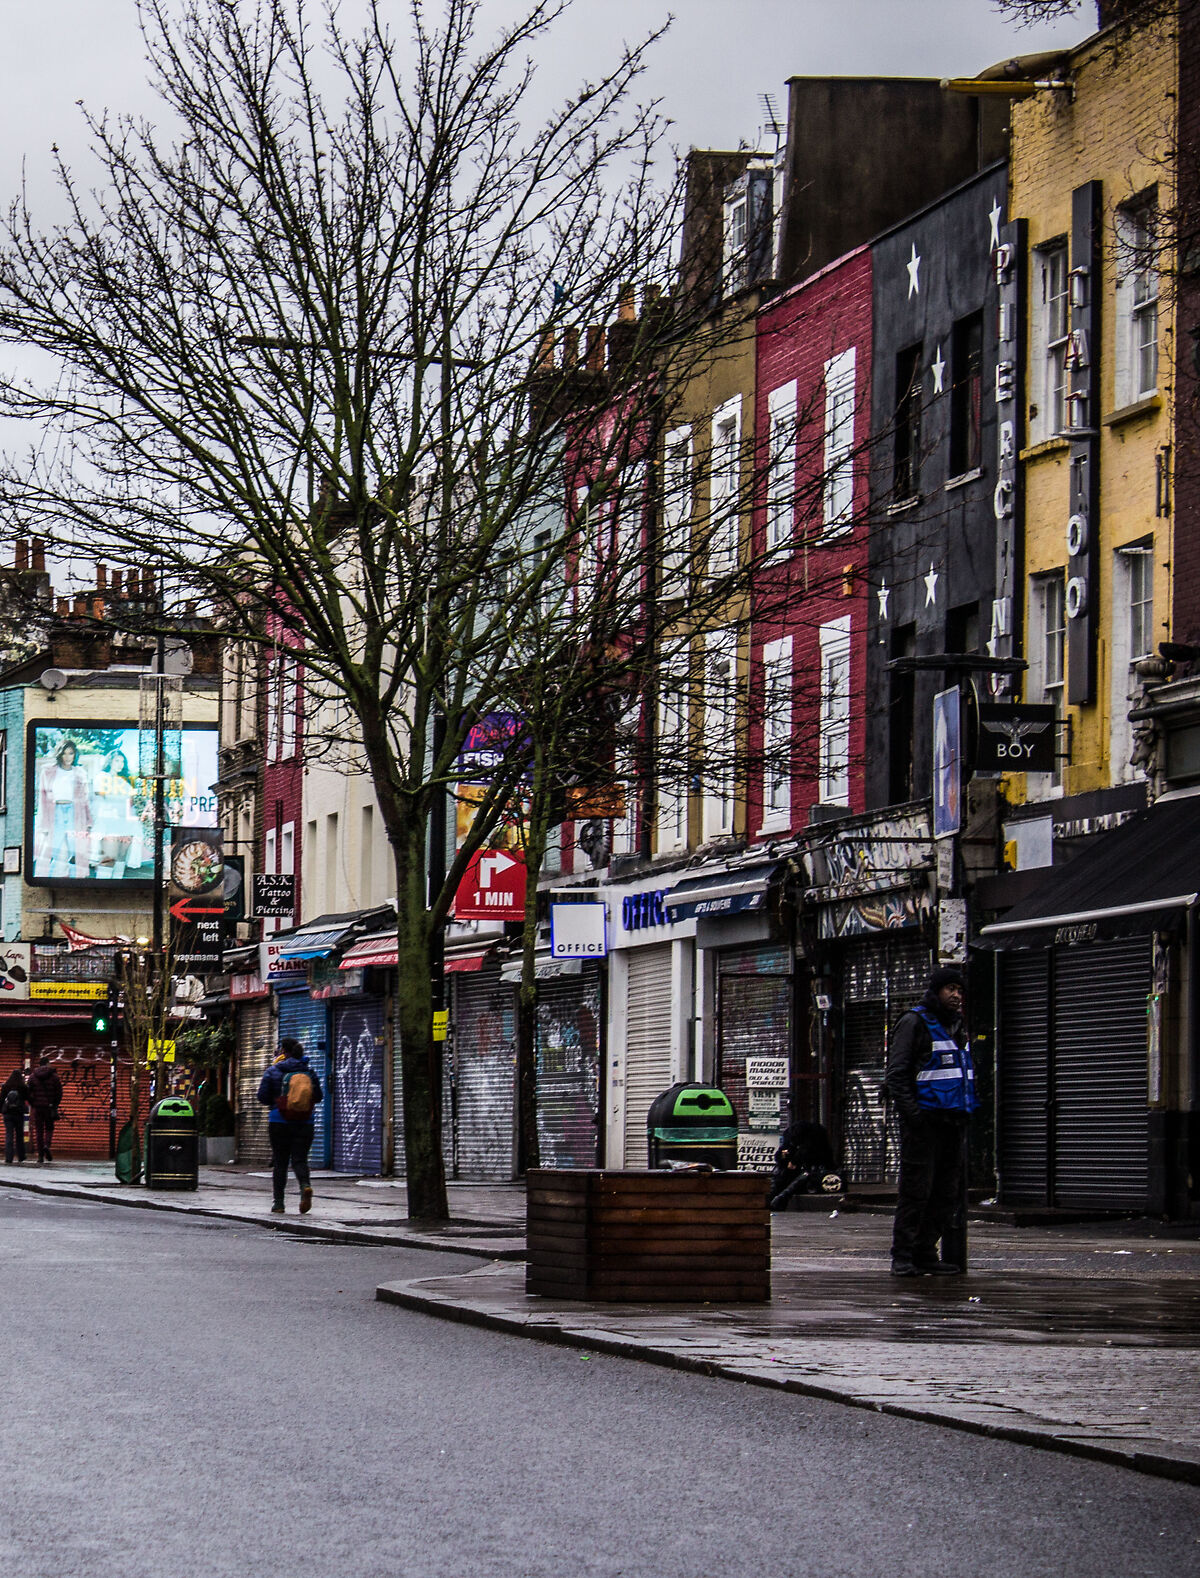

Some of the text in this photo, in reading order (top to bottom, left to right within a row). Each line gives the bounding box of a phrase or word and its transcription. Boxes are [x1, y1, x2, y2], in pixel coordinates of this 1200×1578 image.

[1064, 264, 1091, 619] TATTOO
[997, 743, 1035, 758] BOY
[259, 886, 291, 897] Tattoo
[270, 897, 281, 906] &
[473, 892, 514, 906] 1 MIN
[256, 905, 295, 918] Piercing
[202, 933, 219, 942] left
[268, 946, 284, 955] BU
[557, 943, 603, 953] OFFICE
[268, 960, 309, 971] CHANG
[739, 1146, 776, 1154] ATHER
[739, 1154, 775, 1162] CKETS
